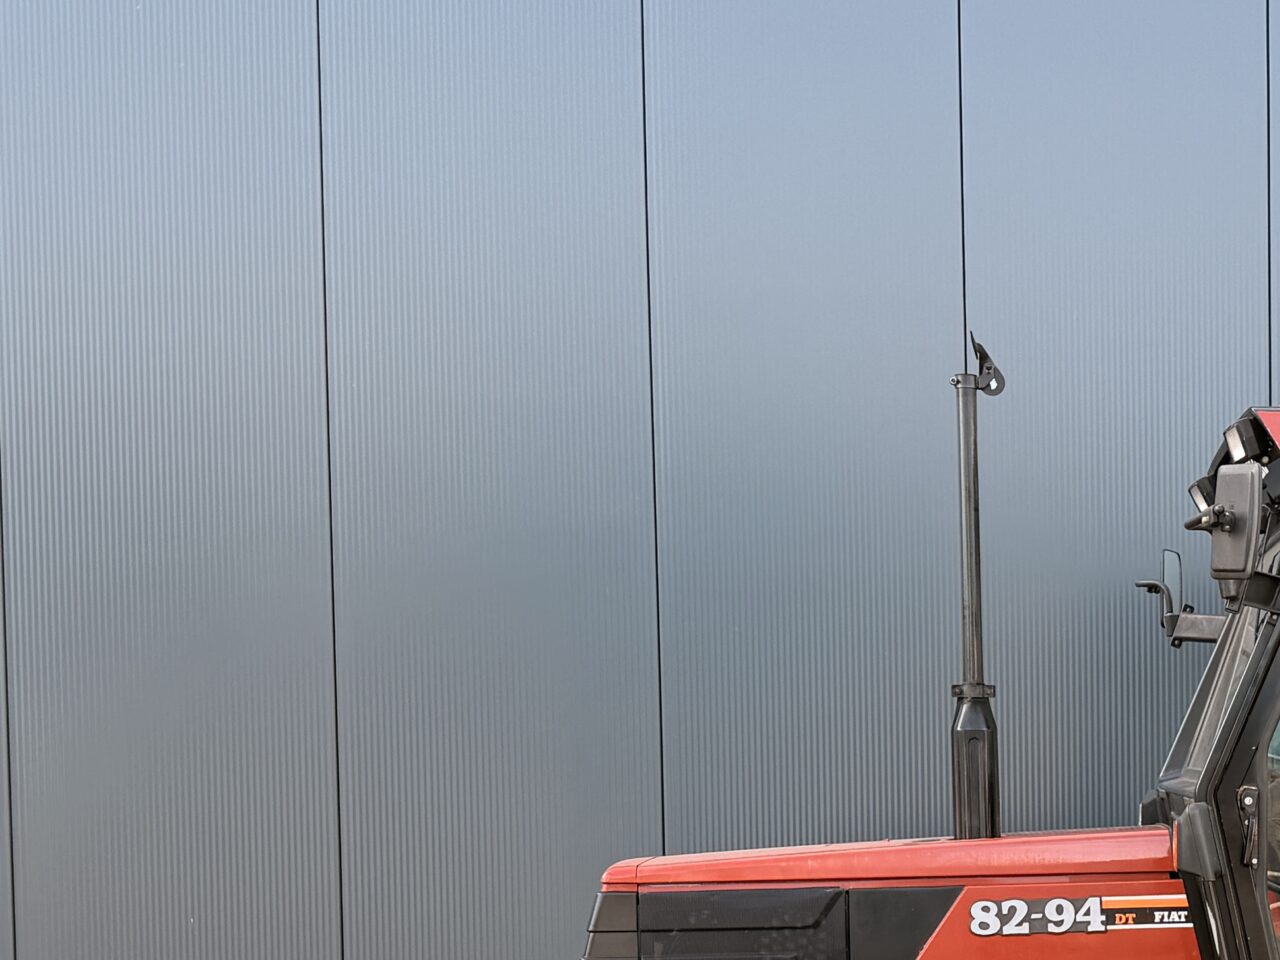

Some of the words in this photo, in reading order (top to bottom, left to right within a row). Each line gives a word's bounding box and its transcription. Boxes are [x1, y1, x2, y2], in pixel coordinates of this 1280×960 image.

[969, 896, 1107, 936] 82-94
[1114, 913, 1136, 924] DT
[1153, 911, 1188, 923] FIAT
